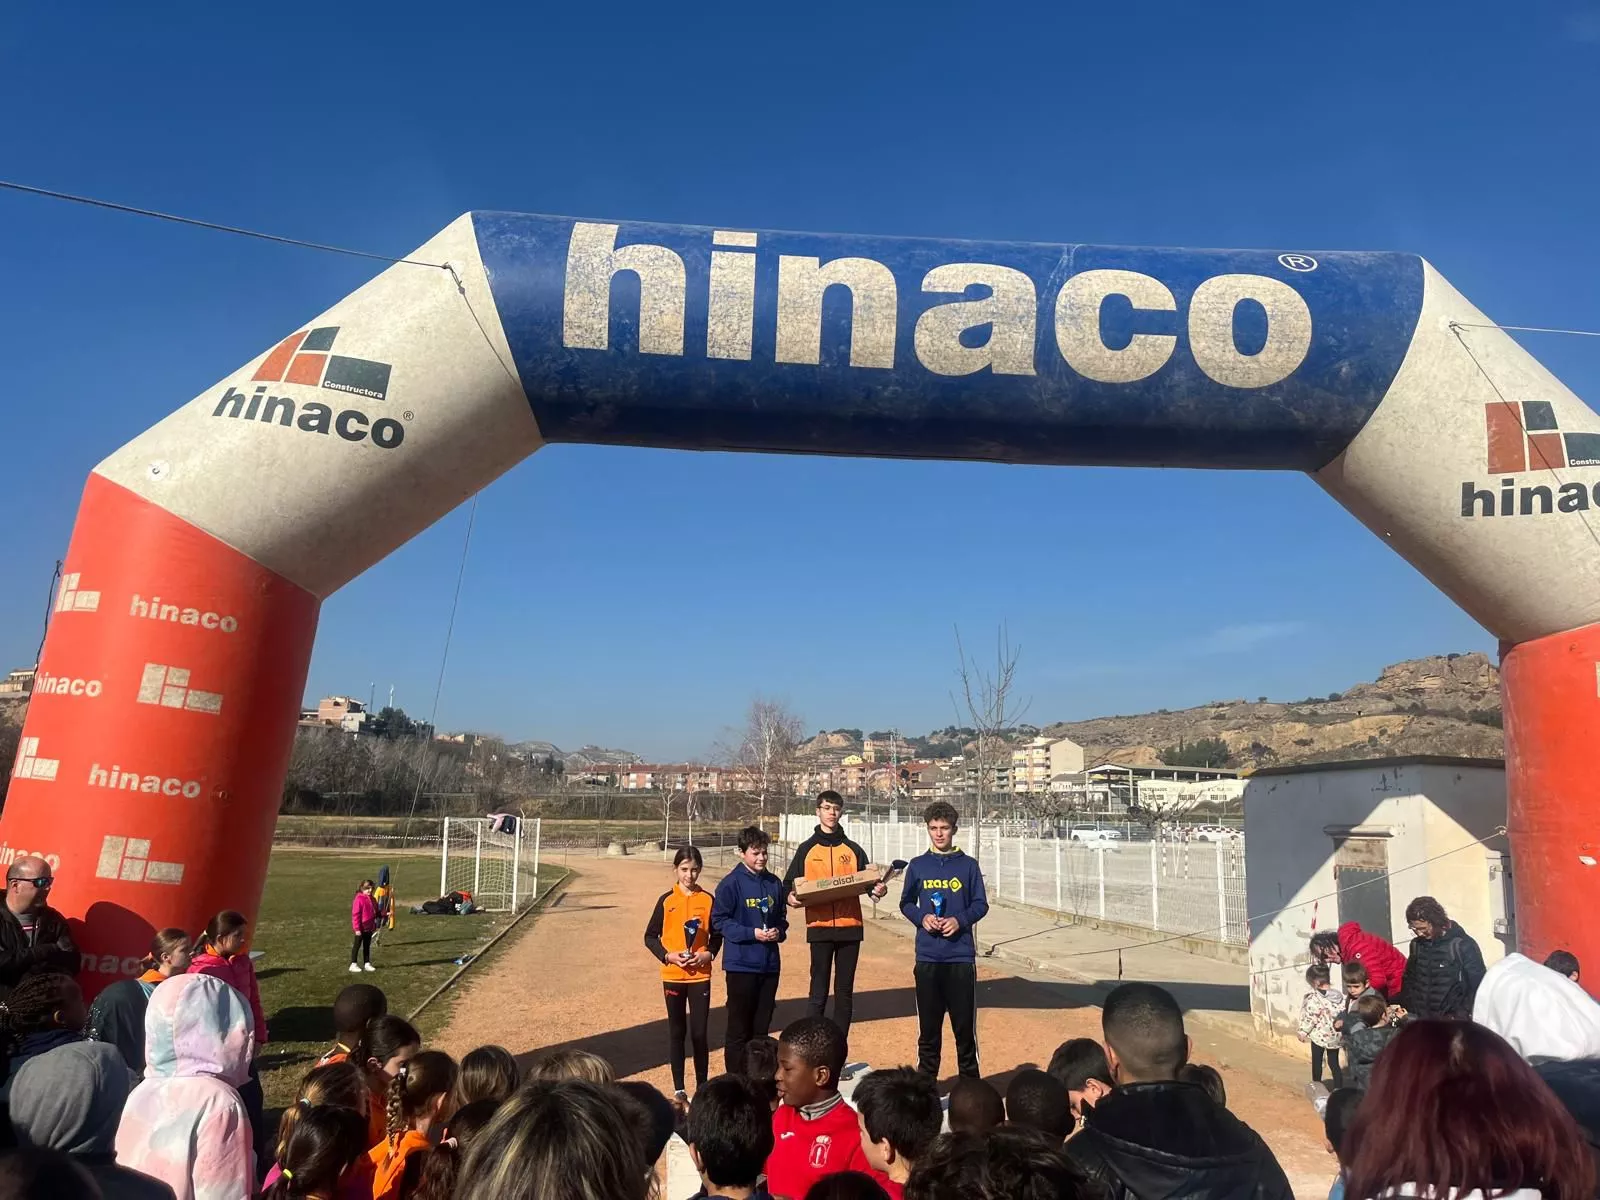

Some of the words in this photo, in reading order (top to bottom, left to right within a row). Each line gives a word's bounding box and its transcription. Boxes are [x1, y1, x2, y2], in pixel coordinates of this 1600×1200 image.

[563, 222, 1312, 389] hinaco
[324, 380, 384, 399] Constructora
[212, 386, 405, 449] hinaco
[1461, 477, 1600, 517] hina
[130, 594, 238, 633] hinaco
[35, 673, 103, 697] hinaco
[88, 763, 201, 798] hinaco
[81, 952, 143, 975] nac
